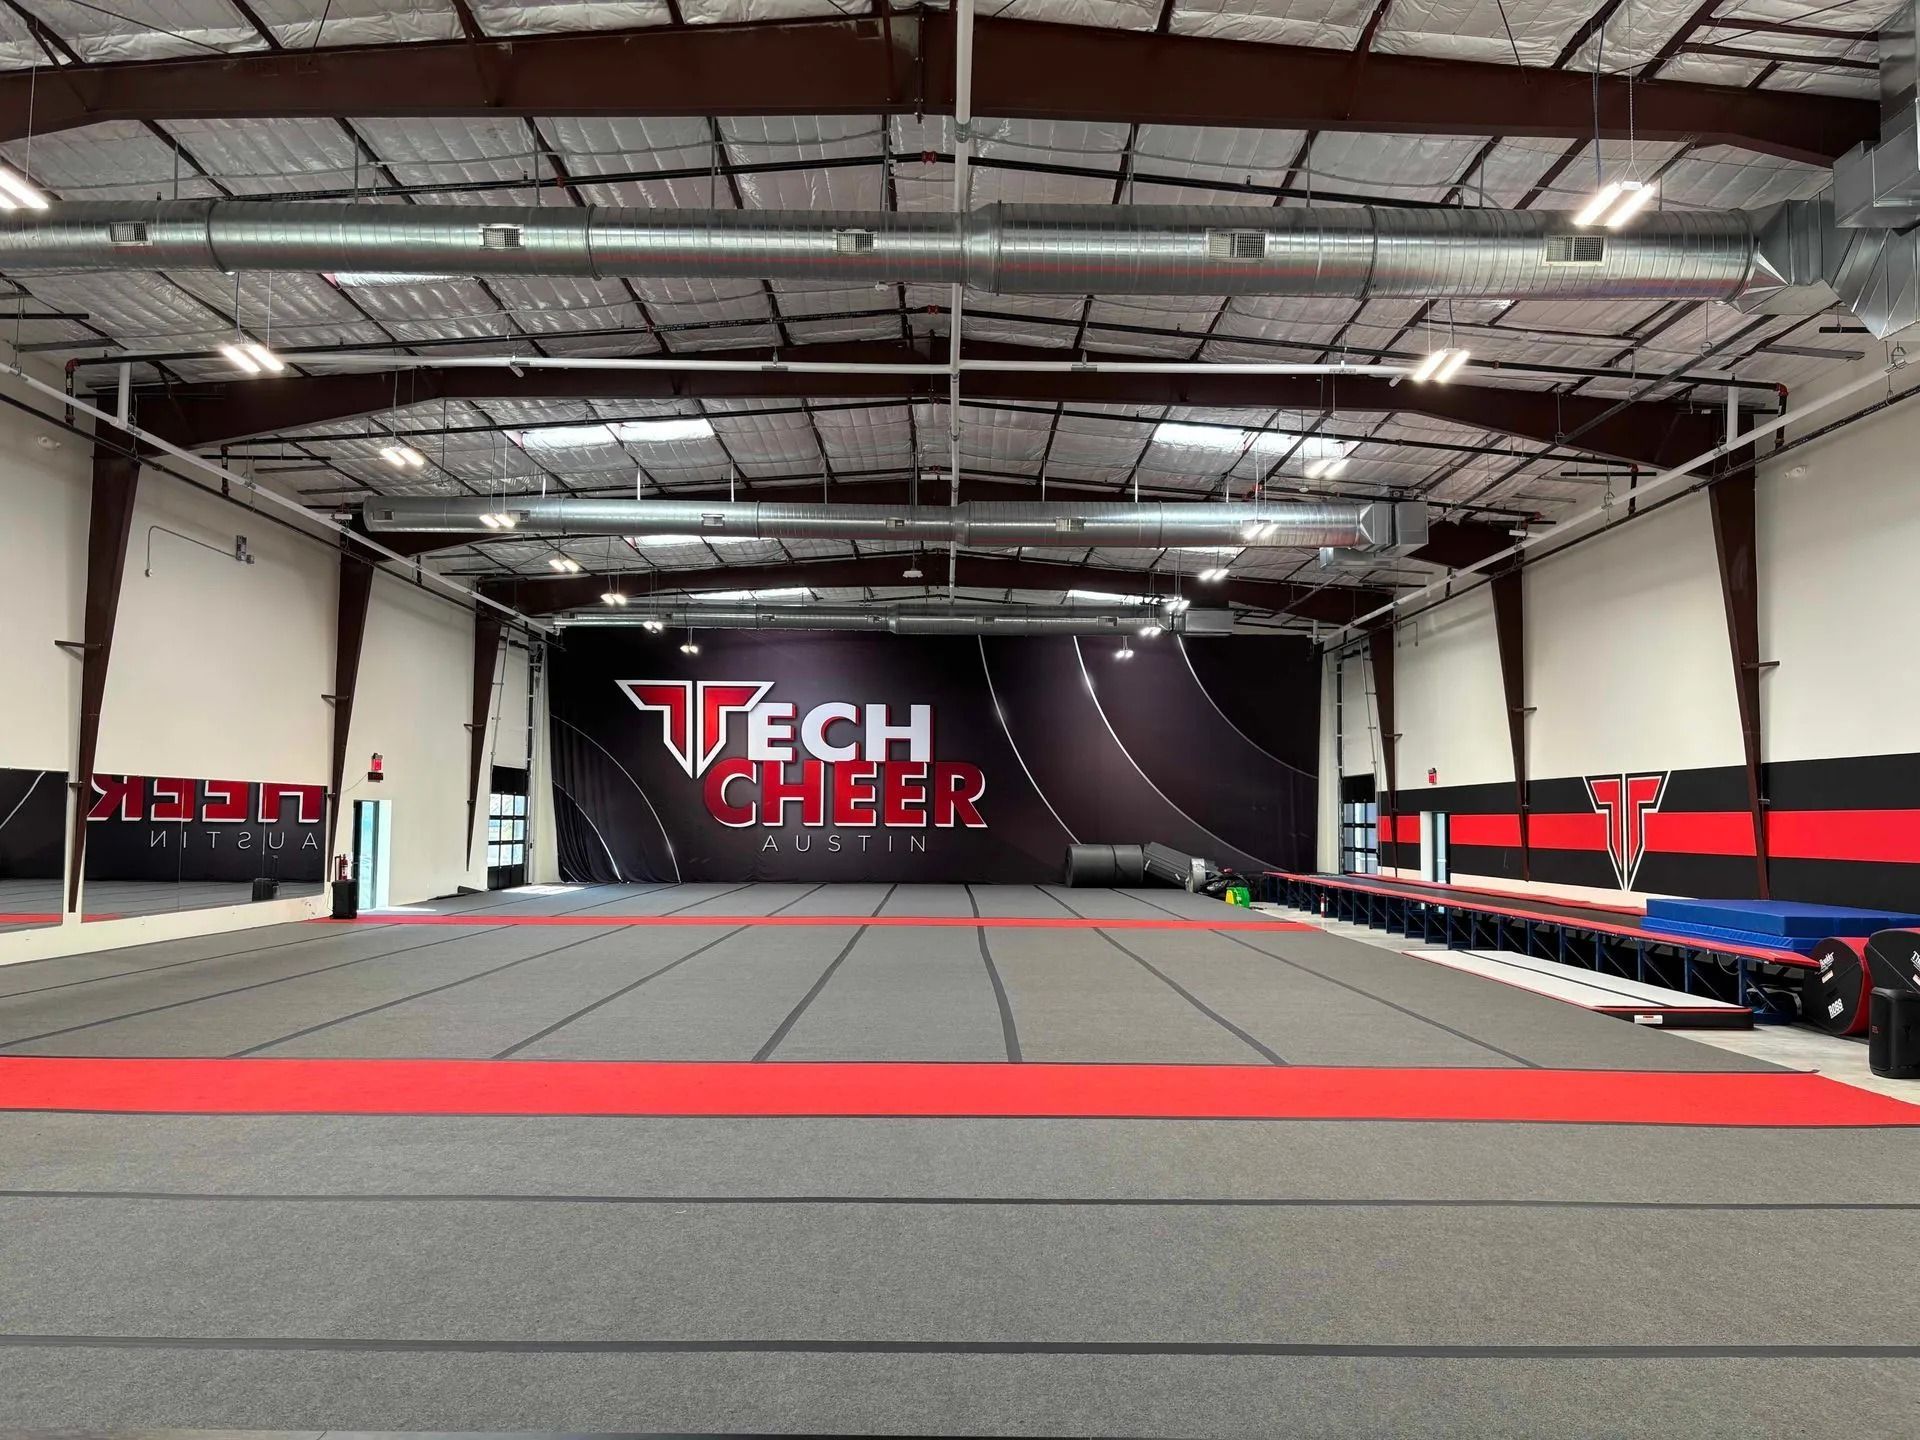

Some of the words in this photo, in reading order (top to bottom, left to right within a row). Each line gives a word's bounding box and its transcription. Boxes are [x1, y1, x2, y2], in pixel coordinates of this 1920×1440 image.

[614, 680, 936, 779] TECH
[703, 757, 988, 828] CHEER
[762, 834, 927, 852] AUSTIN
